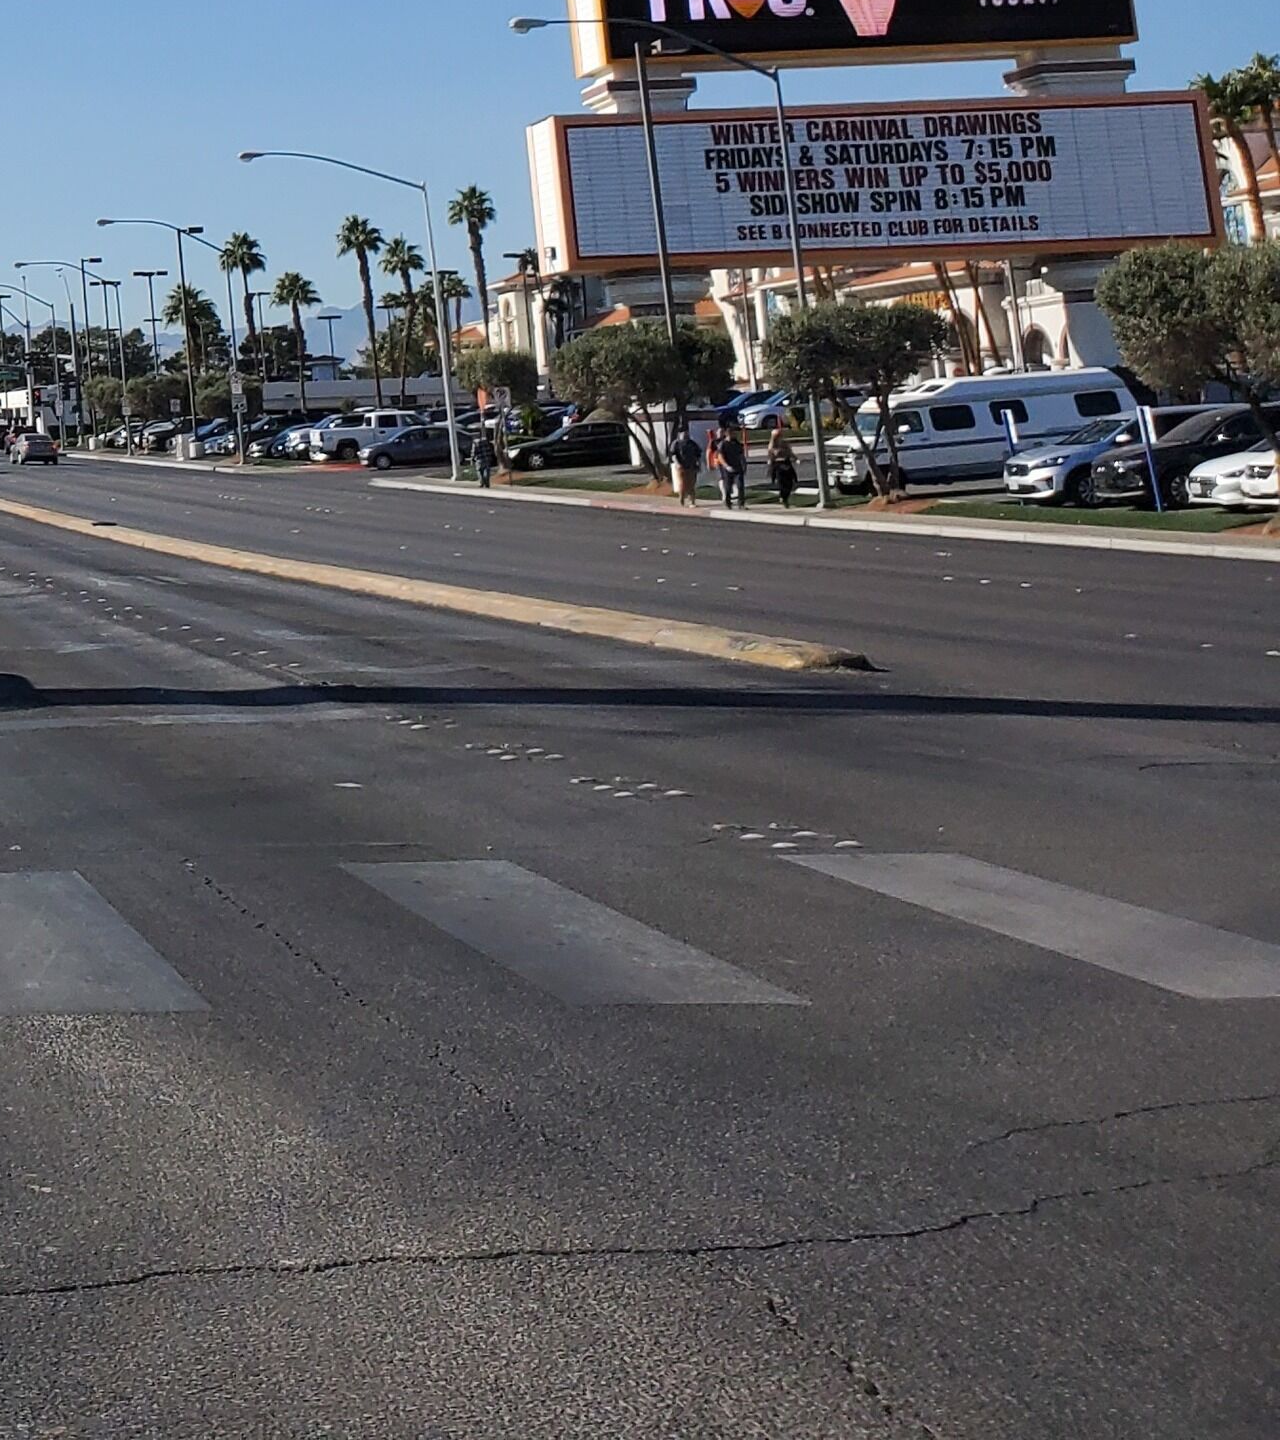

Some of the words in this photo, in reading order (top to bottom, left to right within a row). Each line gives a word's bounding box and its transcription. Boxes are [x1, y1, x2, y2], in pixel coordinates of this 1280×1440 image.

[710, 122, 795, 146] WINTER
[806, 118, 913, 142] CARNIVAL
[924, 112, 1042, 138] DRAWINGS
[704, 146, 785, 170] FRIDAYS
[799, 145, 815, 167] &
[824, 140, 949, 166] SATURDAYS
[961, 137, 1013, 160] 7:15
[1020, 135, 1057, 158] PM
[715, 172, 731, 193] 5
[844, 166, 890, 189] WIN
[899, 165, 929, 187] UP
[935, 163, 965, 185] TO
[974, 160, 1052, 185] $5,000
[750, 191, 859, 216] SIDSHOW
[870, 189, 922, 212] SPIN
[933, 187, 985, 210] 8:15
[990, 185, 1026, 208] PM
[737, 224, 767, 241] SEE
[772, 224, 782, 240] B
[888, 219, 929, 236] CLUB
[934, 218, 965, 235] FOR
[968, 215, 1039, 232] DETAILS
